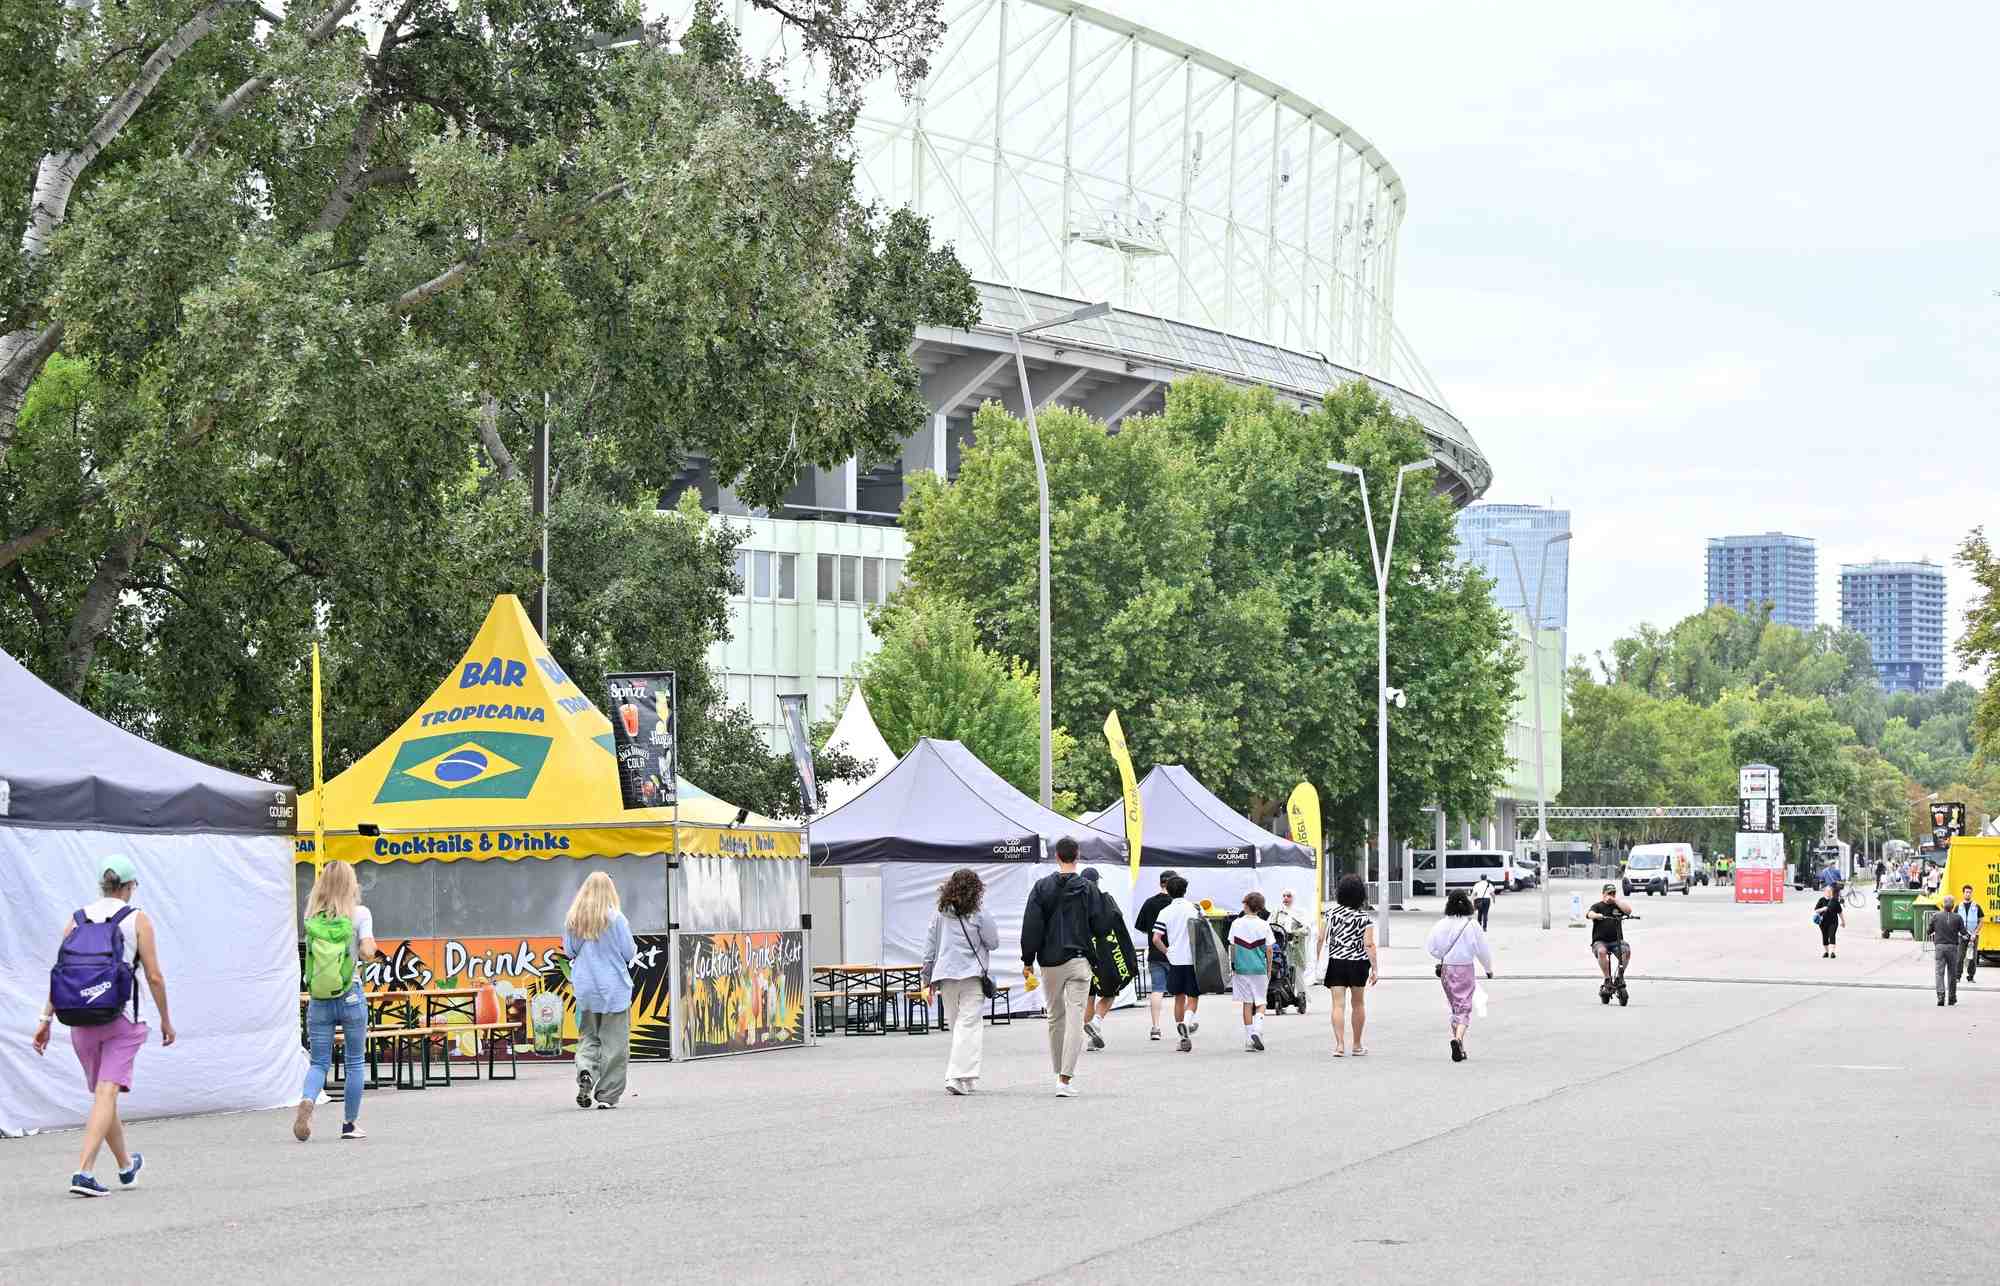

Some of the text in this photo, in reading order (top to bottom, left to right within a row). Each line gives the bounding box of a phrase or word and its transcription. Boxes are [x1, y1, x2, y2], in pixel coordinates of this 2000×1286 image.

[459, 657, 528, 689] BAR
[421, 704, 545, 728] TROPICANA
[269, 806, 295, 818] GOURMET
[374, 832, 570, 857] Cocktails & Drinks
[993, 845, 1032, 854] GOURMET
[358, 945, 432, 986] ails,
[446, 941, 558, 978] Drinks
[745, 935, 777, 968] Drinks
[1112, 944, 1130, 981] YONEX
